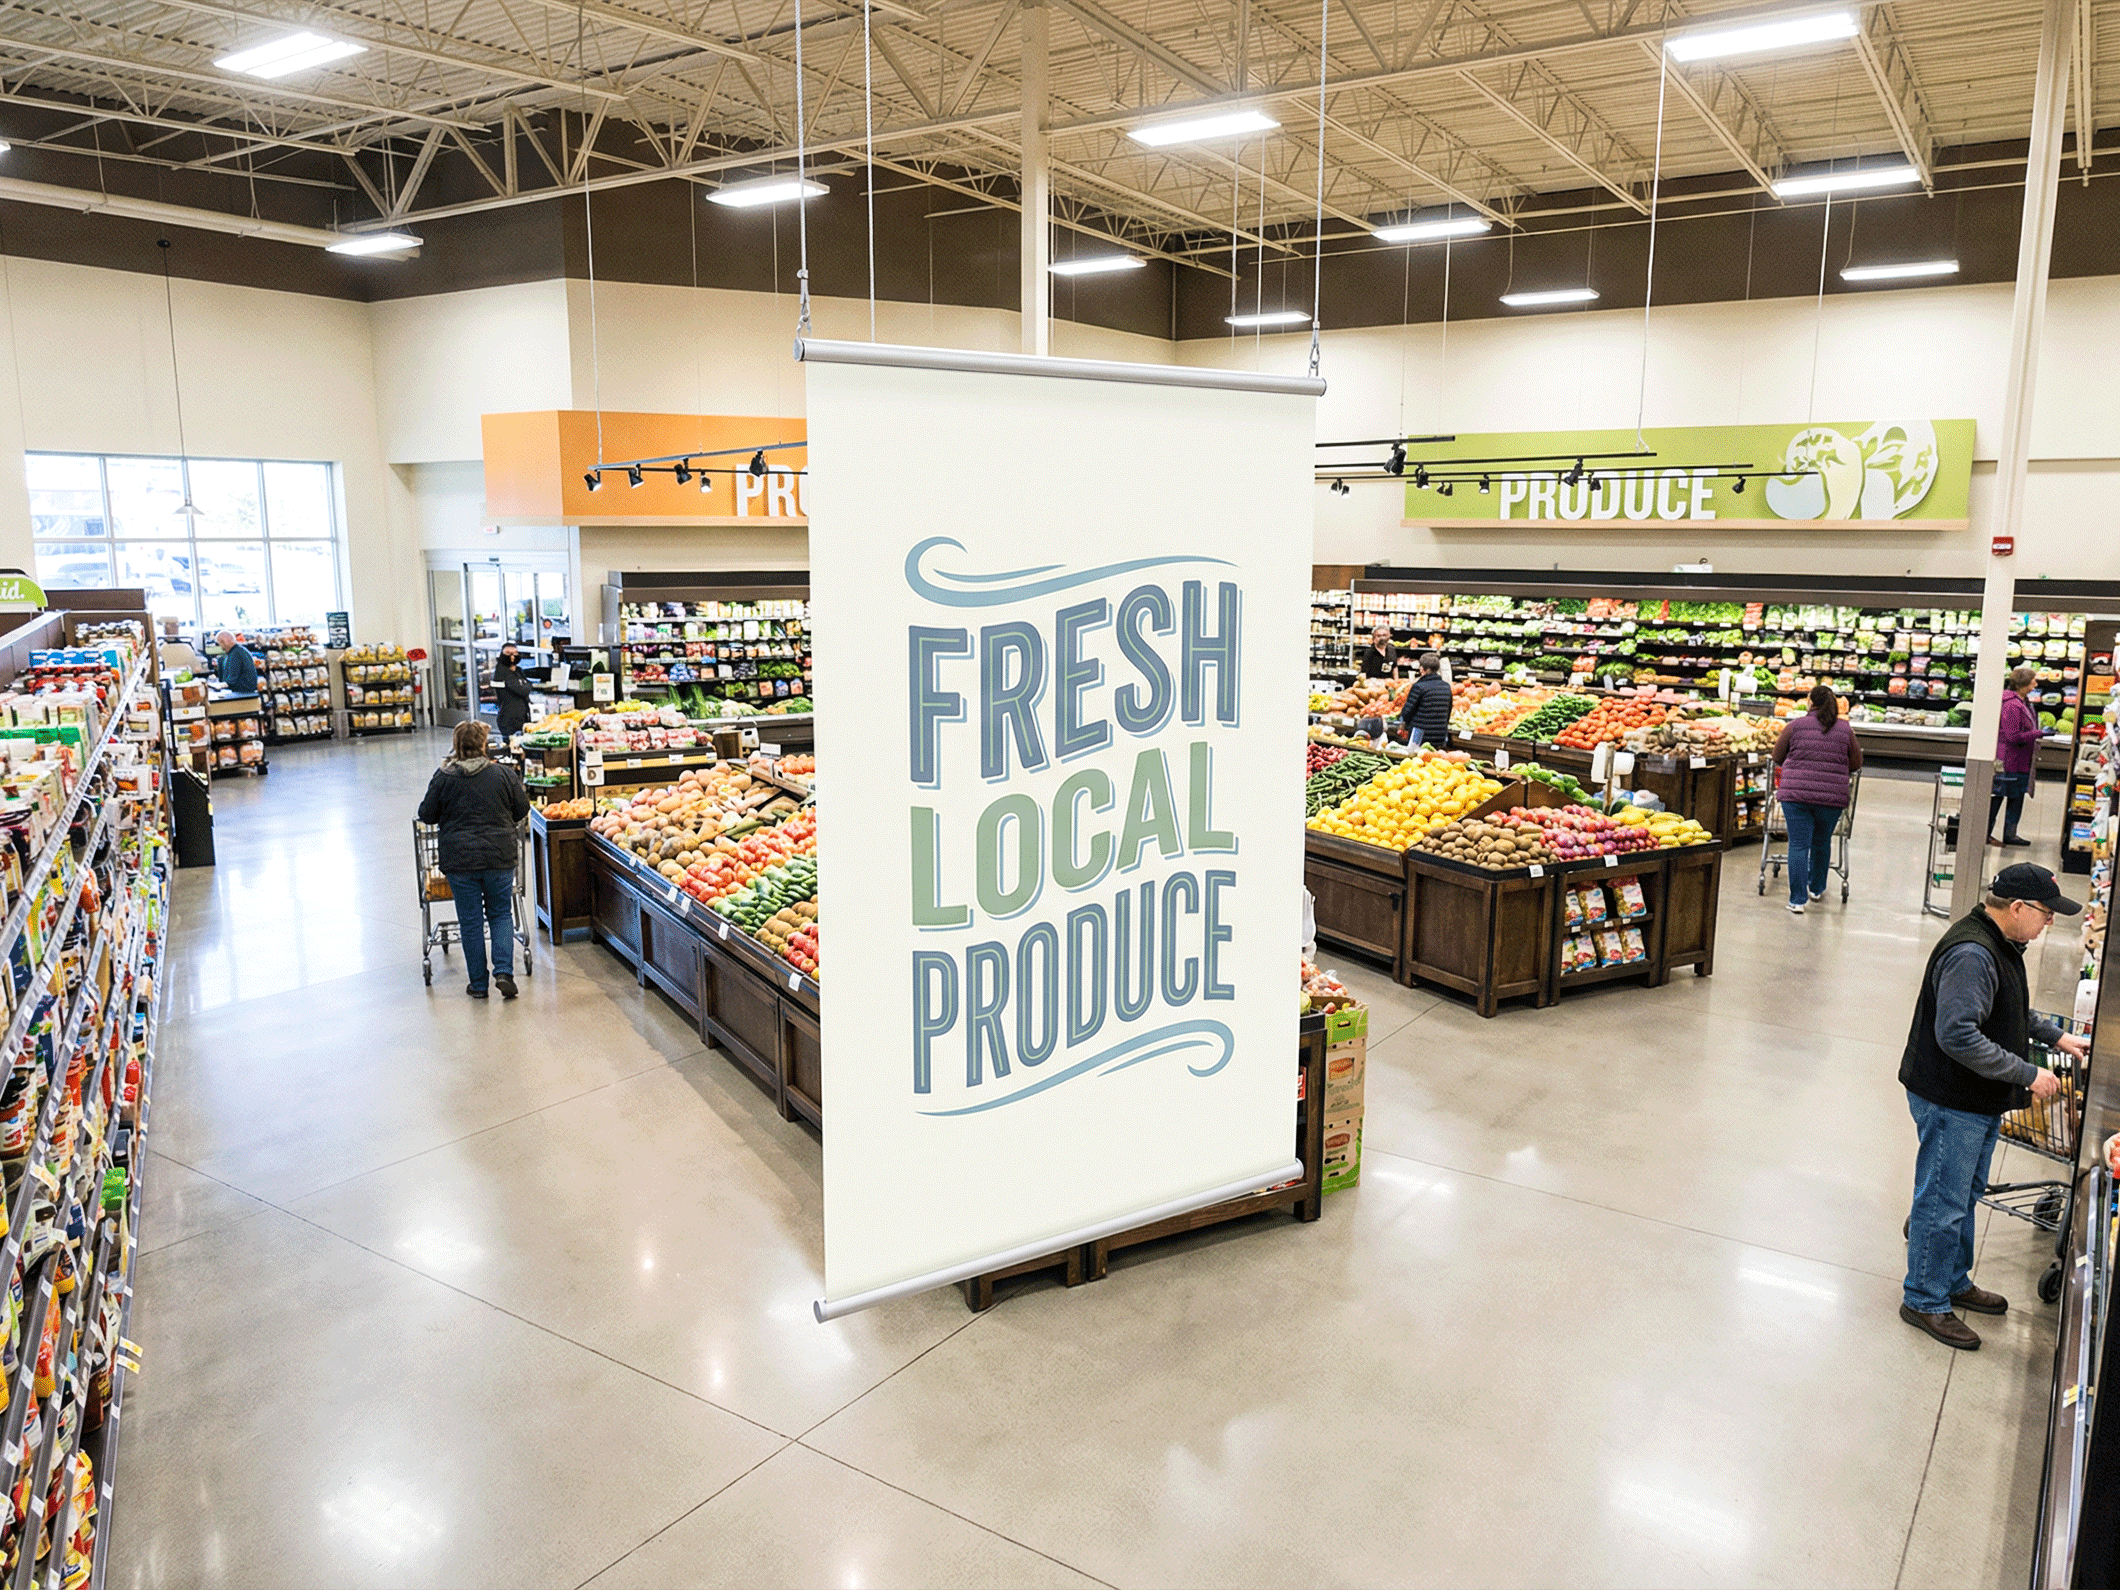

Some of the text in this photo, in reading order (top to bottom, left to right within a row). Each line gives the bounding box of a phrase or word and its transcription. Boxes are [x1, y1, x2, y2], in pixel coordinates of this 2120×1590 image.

[1500, 468, 1718, 521] PRODUCE
[908, 580, 1242, 789] FRESH
[910, 741, 1239, 932] LOCAL
[912, 869, 1237, 1094] PRODUCE
